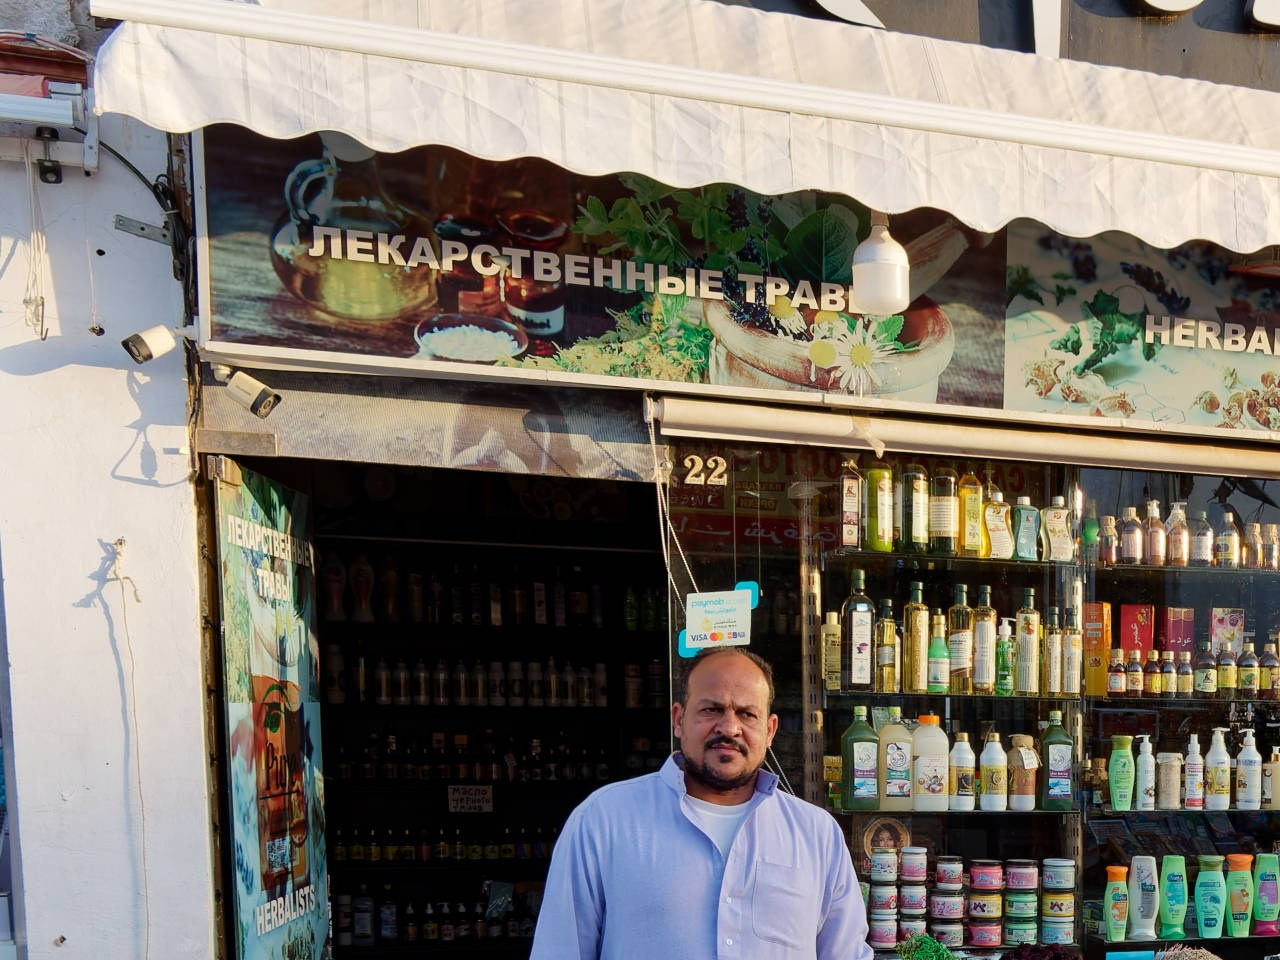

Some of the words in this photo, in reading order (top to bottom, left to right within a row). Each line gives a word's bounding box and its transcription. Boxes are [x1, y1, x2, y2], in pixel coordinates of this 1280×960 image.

[308, 225, 725, 301] ЛЕКАРСТВЕННЫЕ
[737, 272, 868, 314] ТРАВ
[683, 454, 728, 486] 22
[227, 514, 313, 568] ЛЕКАРСТВЕННЫЕ
[257, 568, 291, 602] ТРАВЫ
[690, 632, 708, 642] VISA
[256, 883, 316, 937] HERBALISTS
